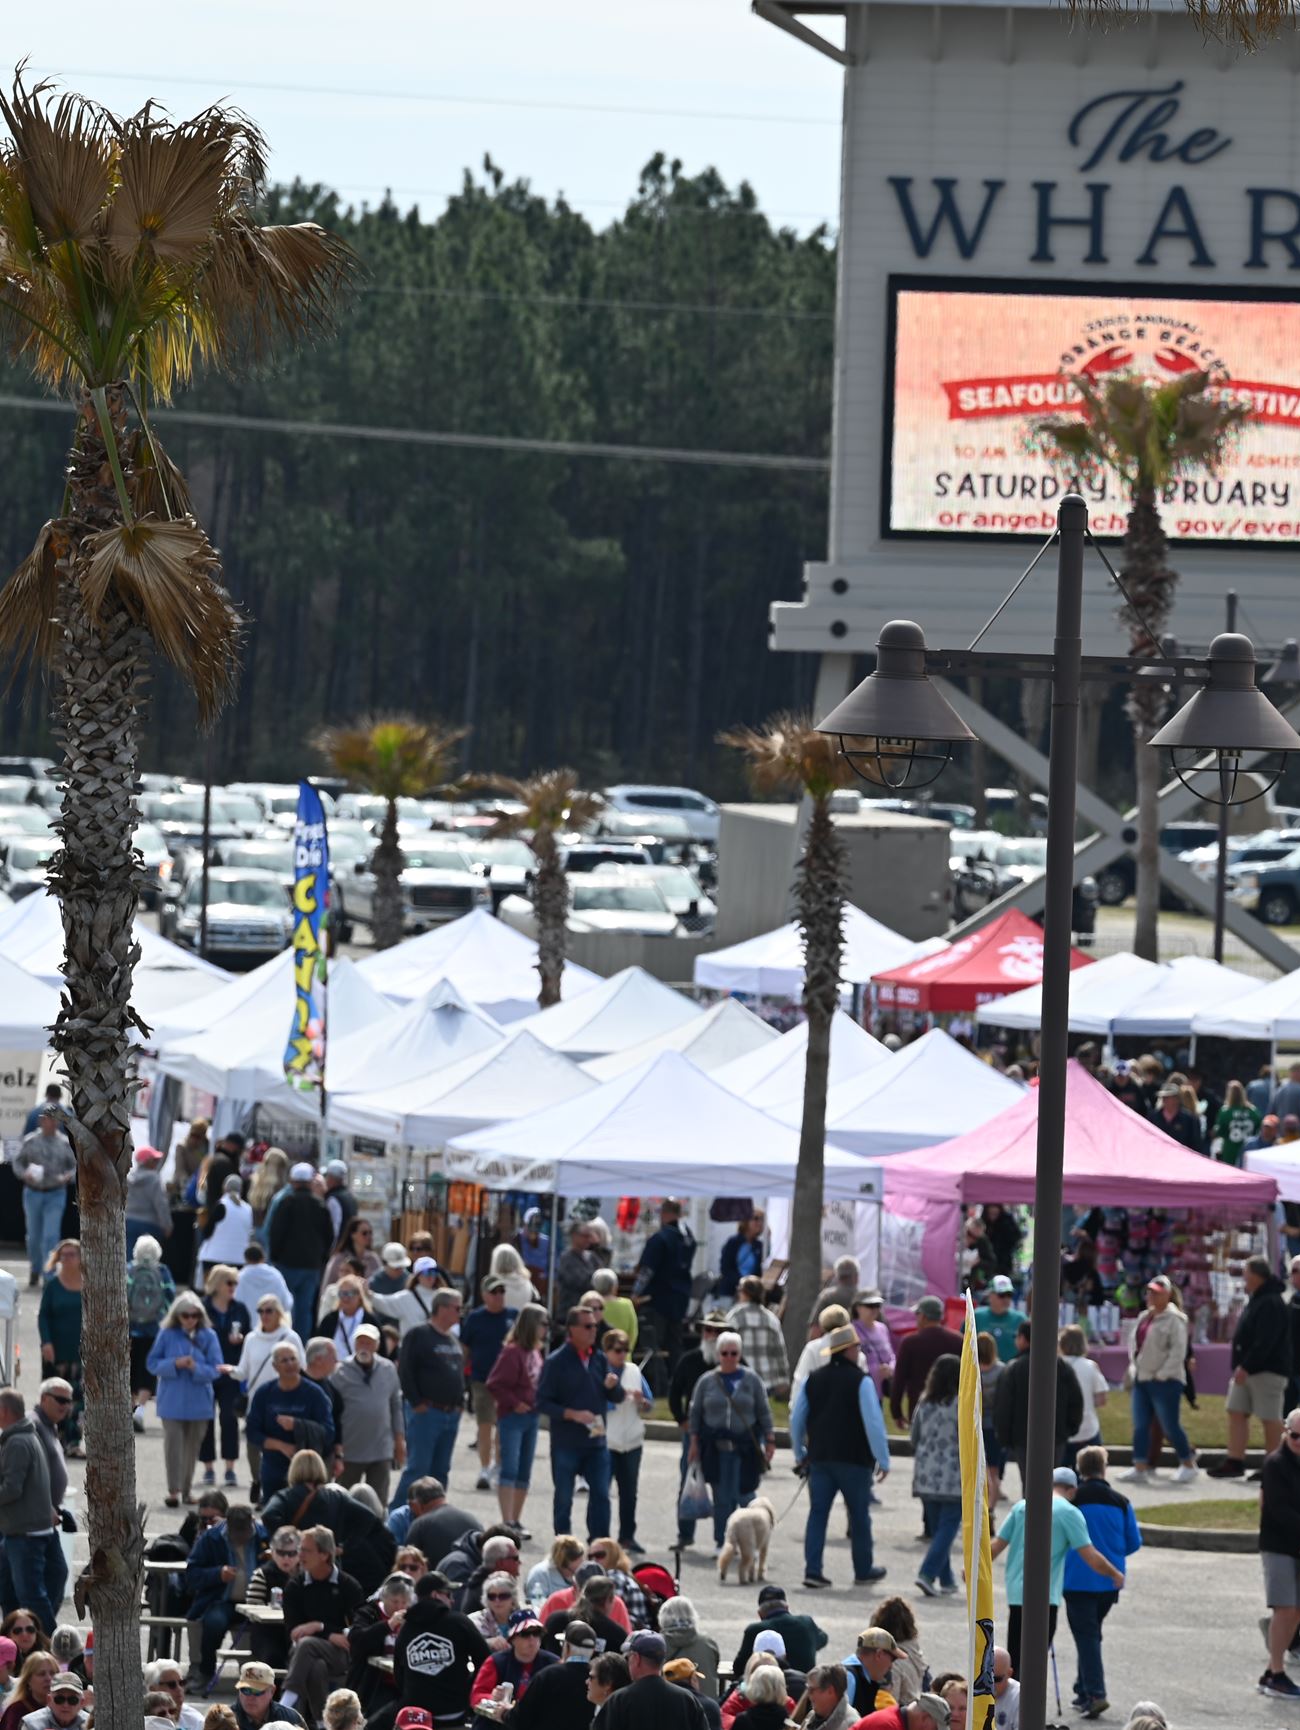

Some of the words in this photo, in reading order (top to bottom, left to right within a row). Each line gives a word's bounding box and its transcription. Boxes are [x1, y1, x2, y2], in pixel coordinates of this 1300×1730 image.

[1067, 80, 1233, 173] The
[1060, 327, 1146, 365] ORANGE
[1159, 330, 1225, 371] BEACH
[957, 383, 1083, 411] SEAFOOD
[1162, 479, 1290, 507] BRUARY
